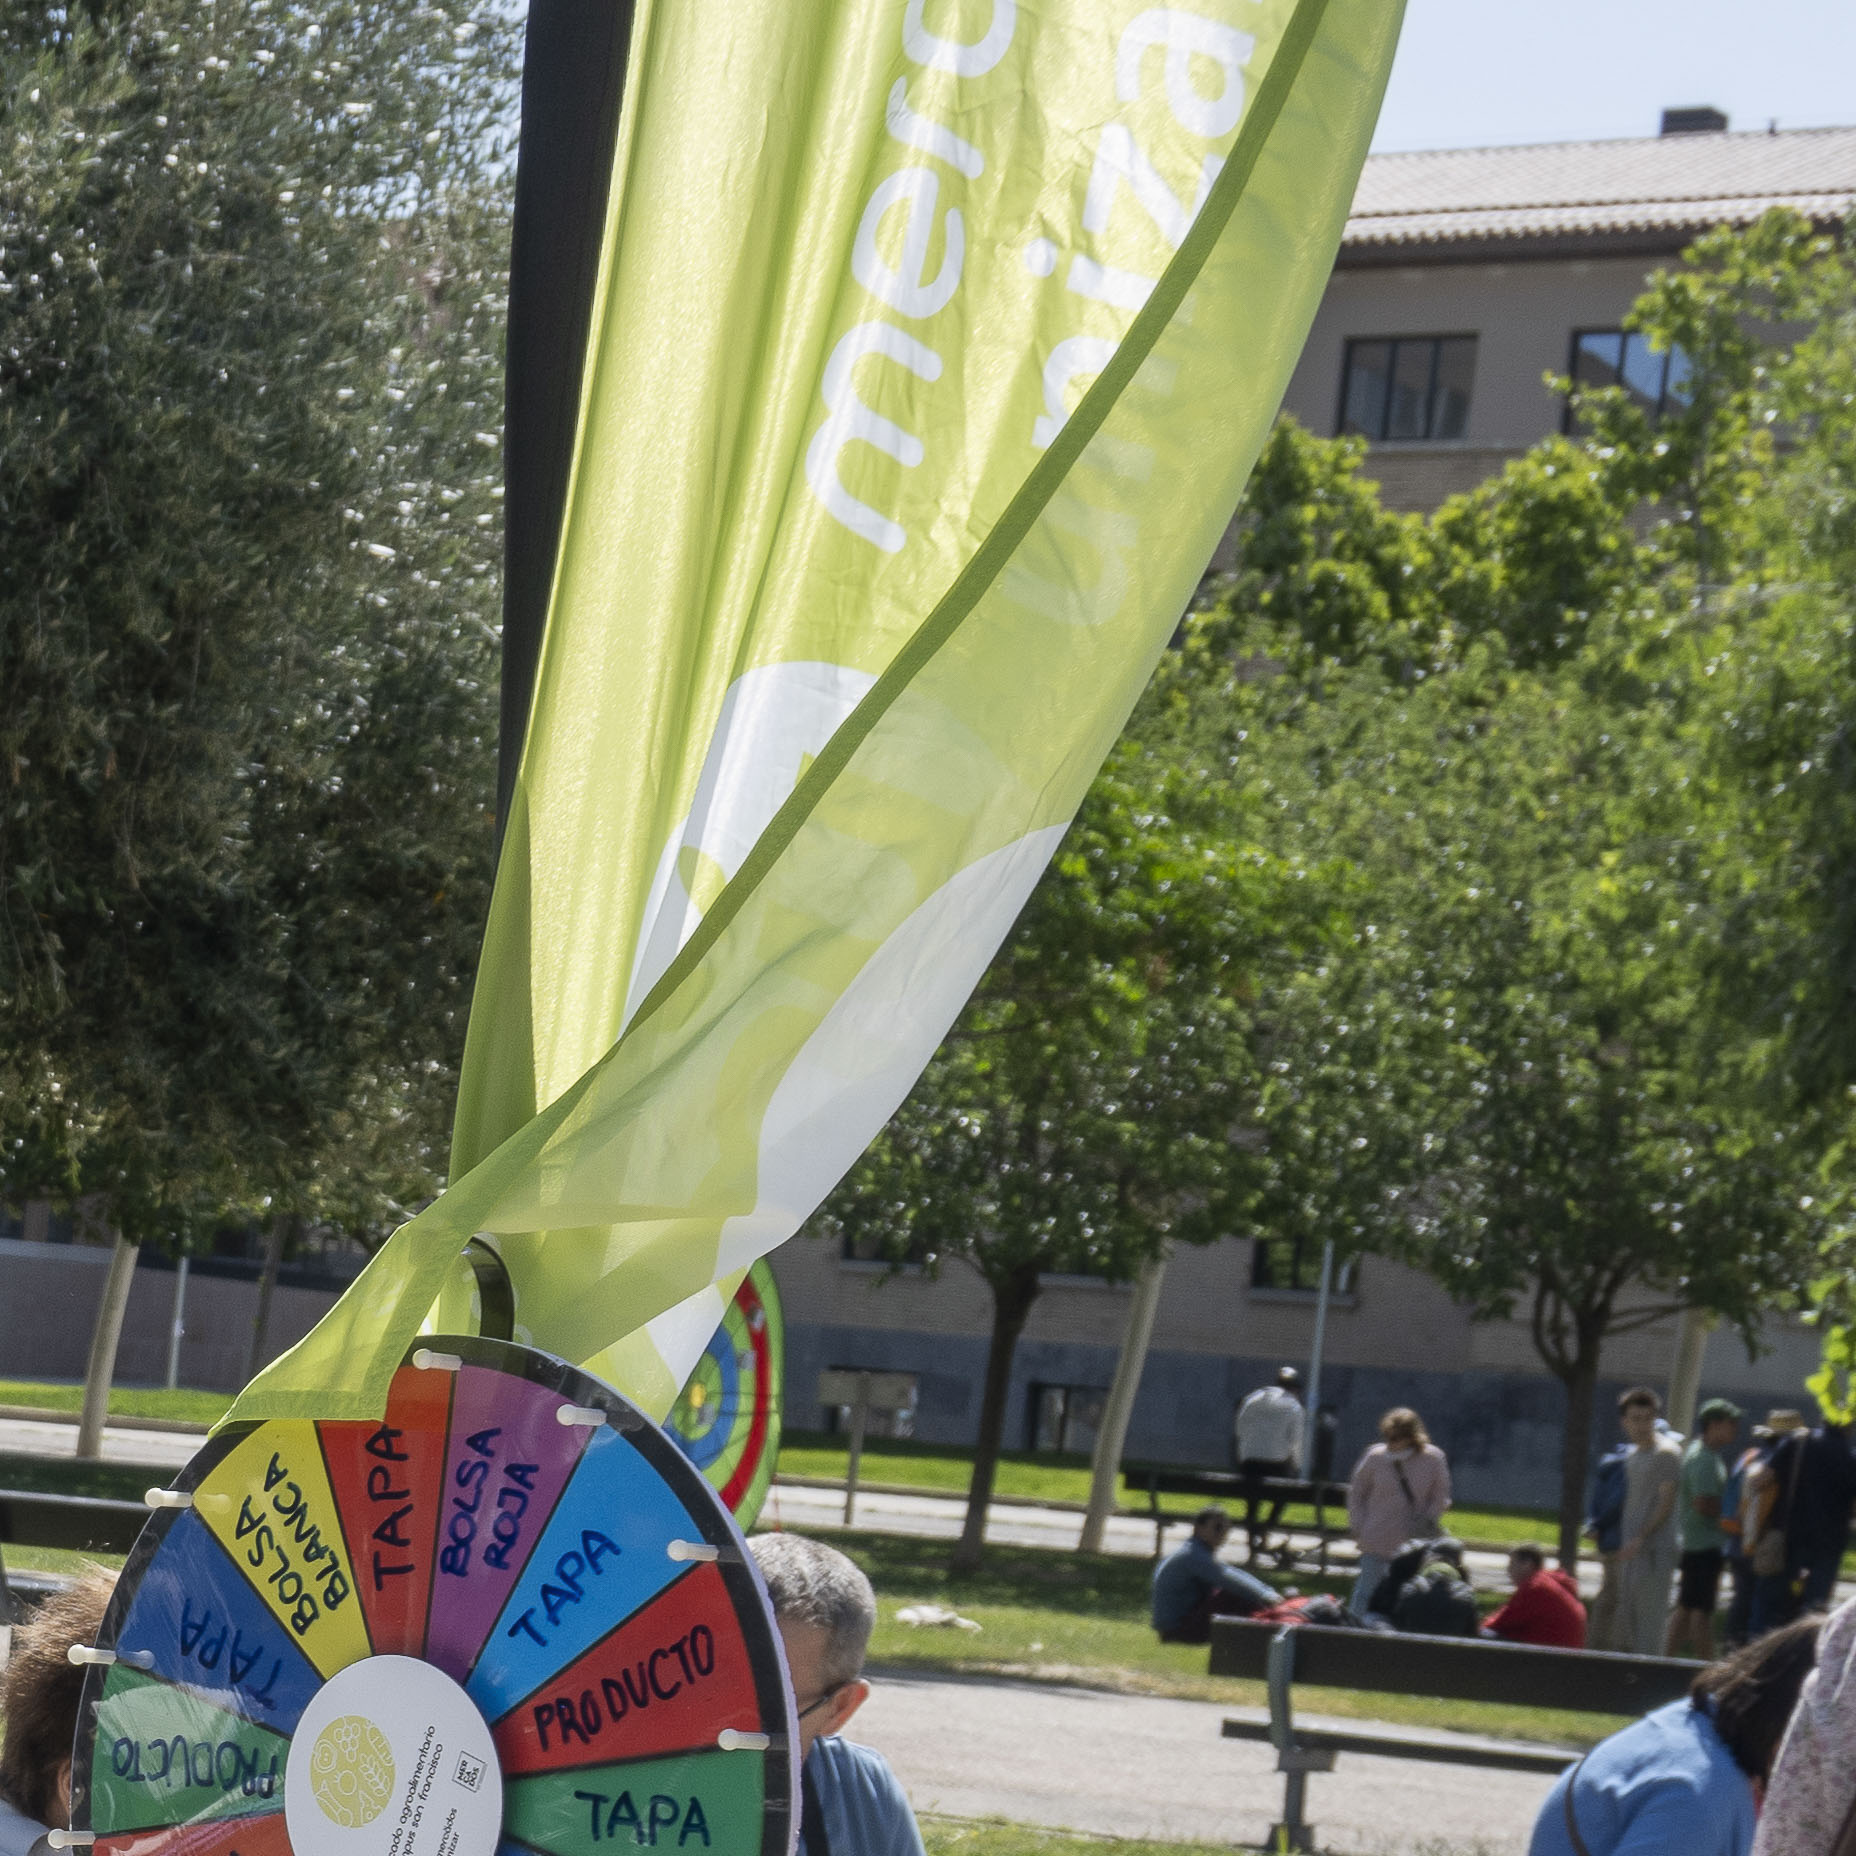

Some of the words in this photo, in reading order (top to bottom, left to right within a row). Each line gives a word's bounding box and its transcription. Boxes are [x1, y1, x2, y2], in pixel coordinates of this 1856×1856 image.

[264, 1452, 350, 1610] BLANCA
[365, 1424, 415, 1591] TAPA
[440, 1427, 502, 1577] BOLSA
[483, 1463, 539, 1570] ROJA
[236, 1495, 319, 1635] BOLSA
[507, 1530, 621, 1647] TAPA
[180, 1598, 282, 1711] TAPA
[534, 1624, 714, 1752] PRODUCTO
[112, 1735, 277, 1799] PRODUCTO
[400, 1725, 436, 1824] agroalimentario
[412, 1805, 424, 1828] san
[418, 1743, 443, 1801] francisco
[574, 1790, 711, 1847] TAPA
